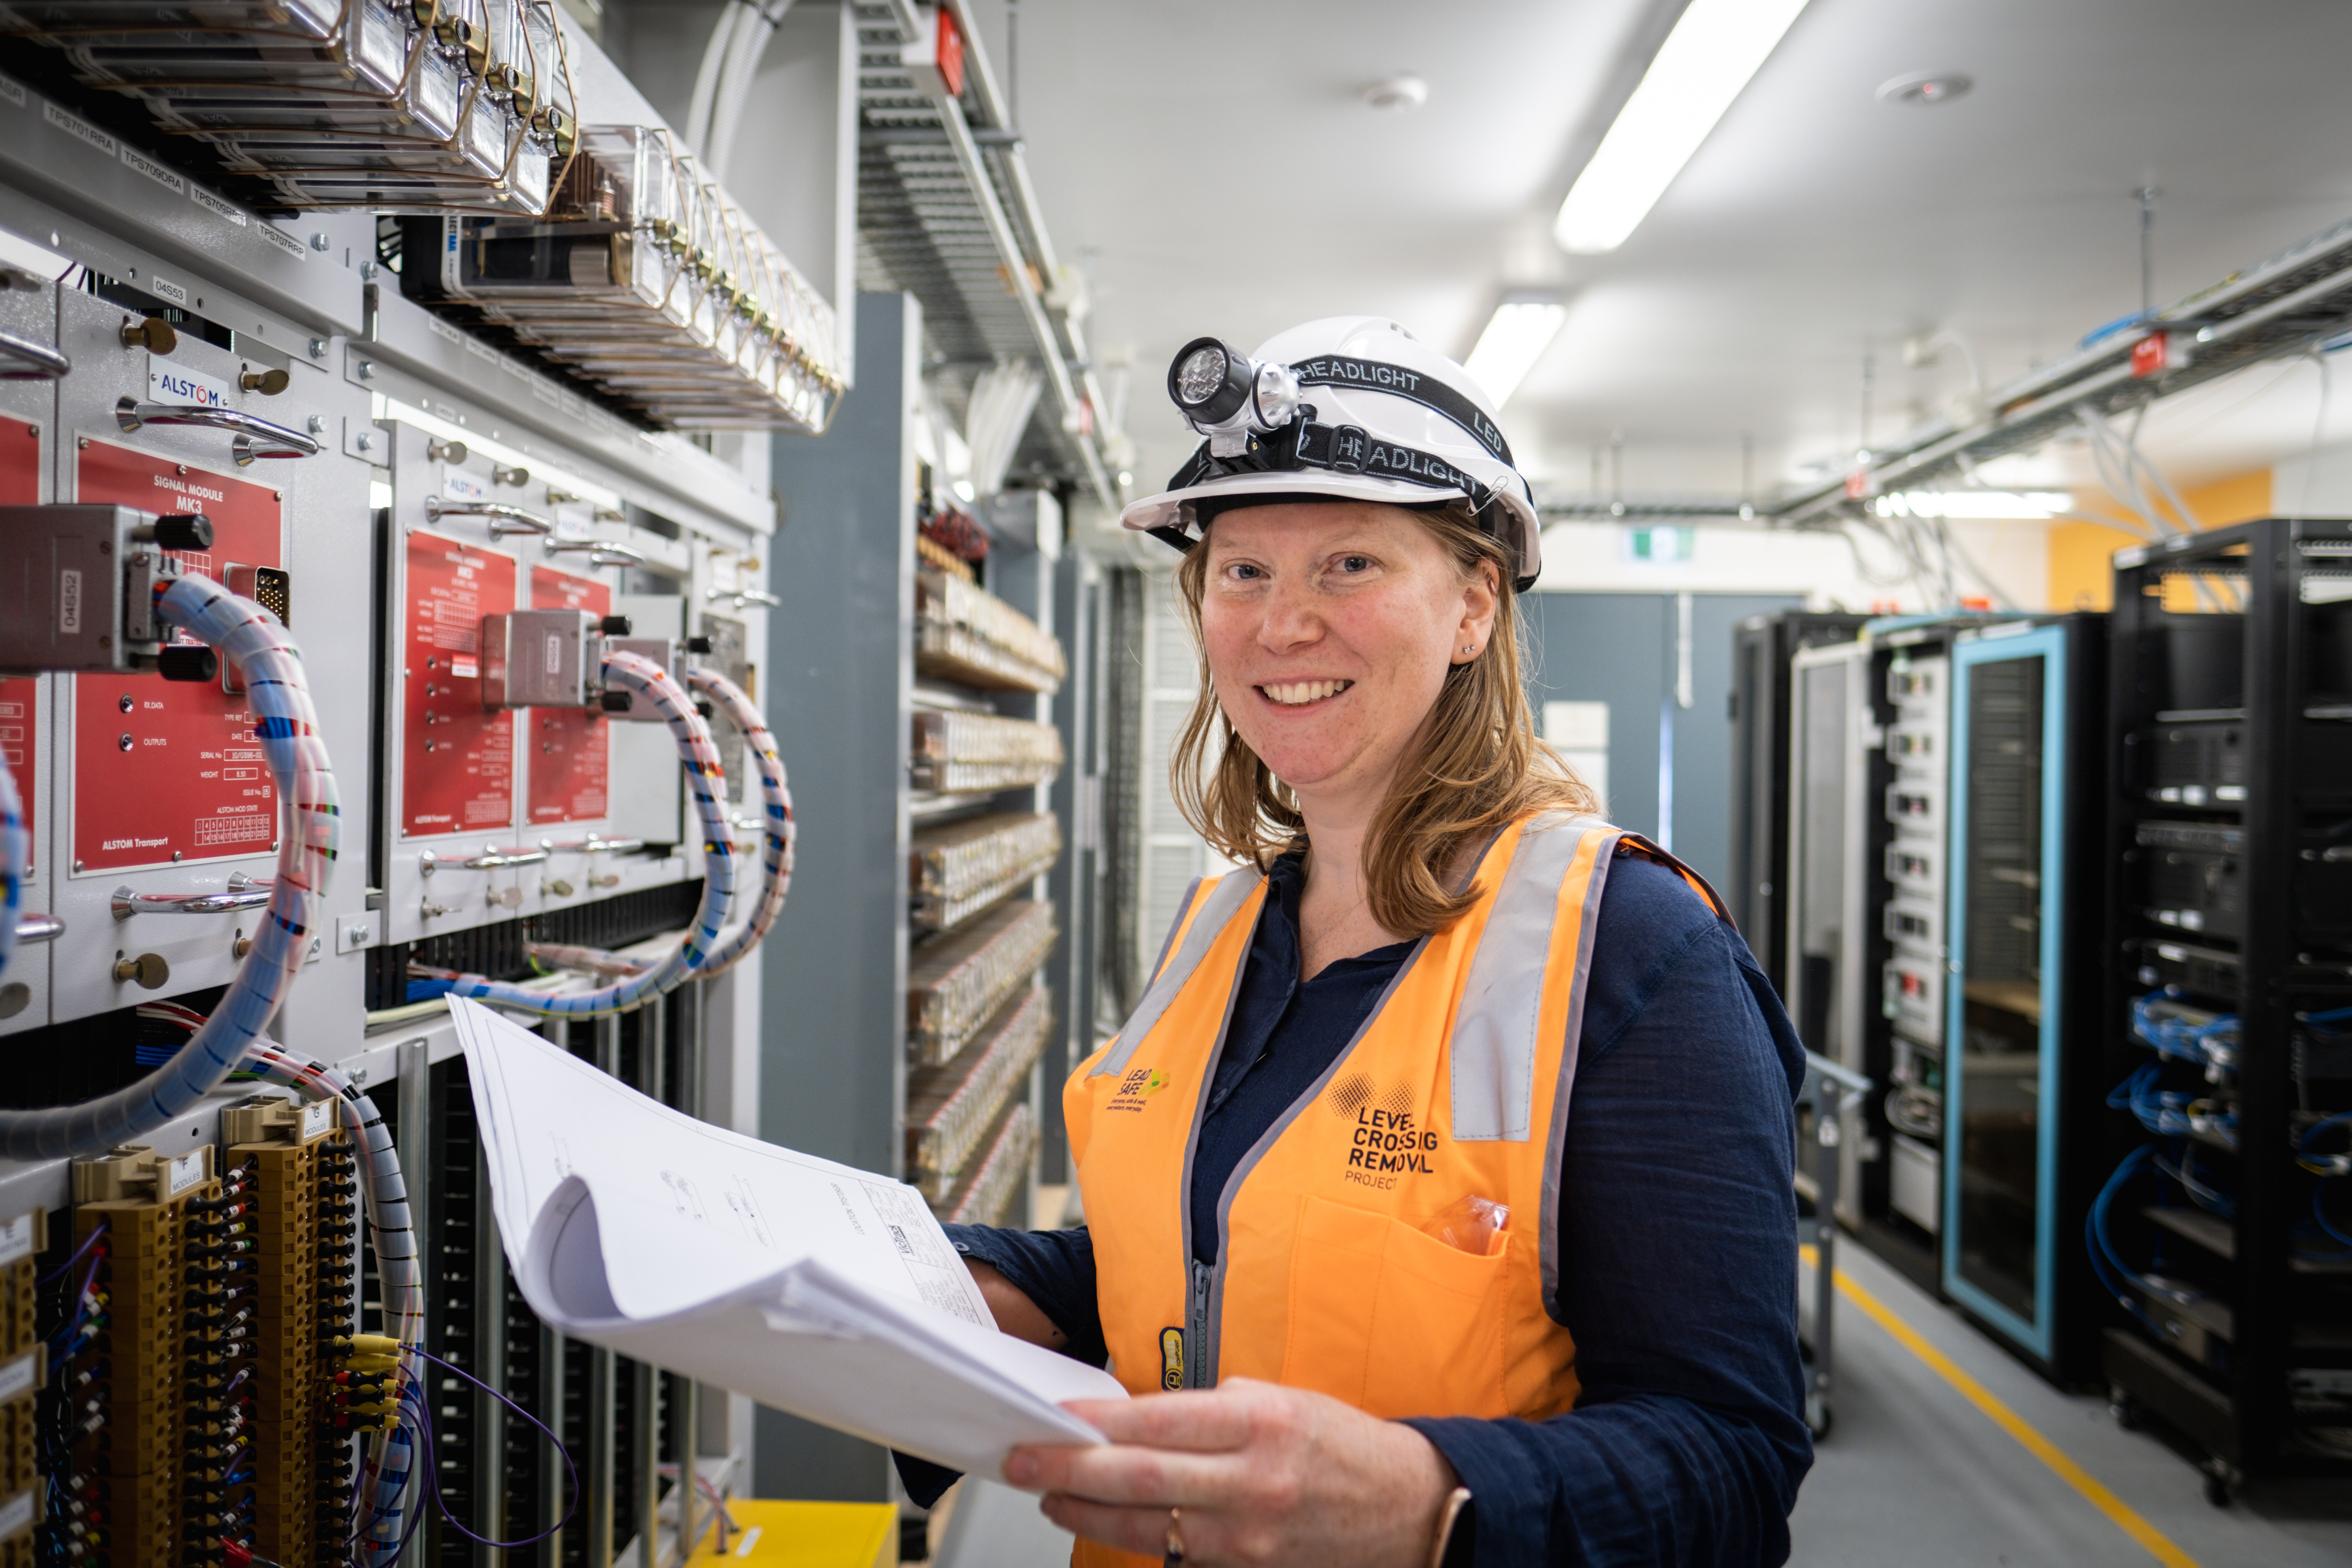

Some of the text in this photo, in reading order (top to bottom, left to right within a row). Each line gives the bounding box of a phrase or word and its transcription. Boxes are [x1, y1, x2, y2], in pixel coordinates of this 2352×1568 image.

[48, 106, 114, 152] TPS701RRA
[124, 151, 182, 190] TPS709DRA
[156, 281, 184, 300] 04S53
[1299, 360, 1420, 391] HEADLIGHT
[162, 375, 218, 407] ALSTOM
[1473, 412, 1502, 453] LED
[154, 475, 223, 502] SIGNAL MODULE
[176, 495, 202, 514] MK3
[64, 574, 77, 628] 04S52
[102, 837, 168, 850] ALSTOM Transport
[1125, 1069, 1153, 1081] LEAD
[1116, 1082, 1144, 1096] SAFE
[314, 1107, 320, 1118] G
[305, 1122, 326, 1135] MODULES
[182, 1158, 188, 1170] F
[173, 1172, 201, 1191] MODULES
[1344, 1170, 1398, 1190] PROJECT
[887, 1223, 911, 1254] VicTrack
[1166, 1338, 1177, 1366] RAIL
